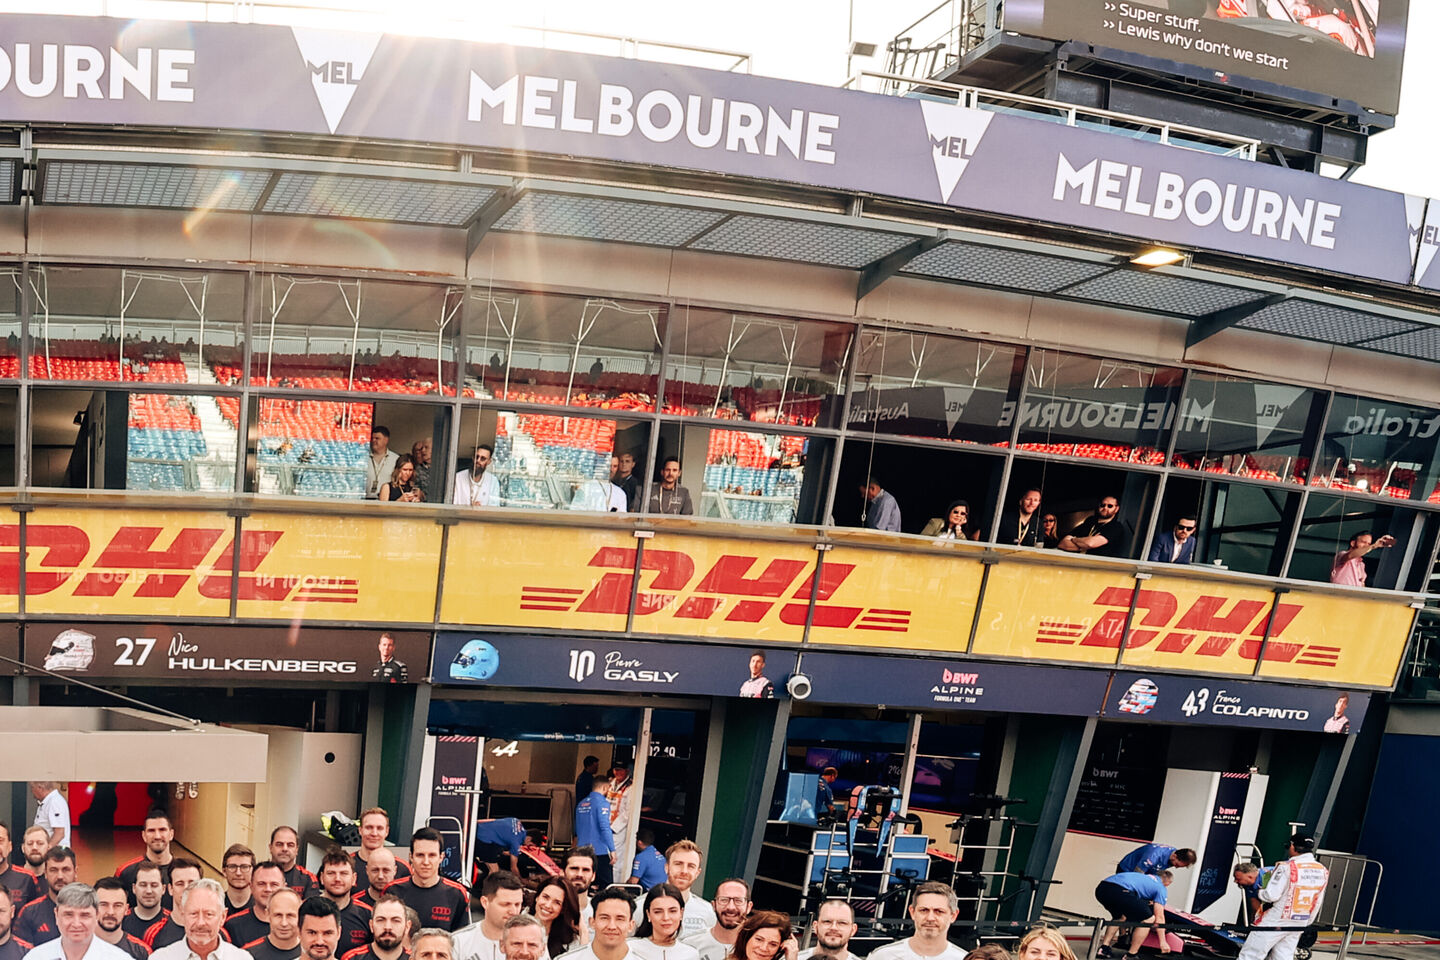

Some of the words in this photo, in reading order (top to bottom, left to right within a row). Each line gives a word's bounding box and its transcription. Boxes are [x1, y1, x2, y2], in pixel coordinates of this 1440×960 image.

[1119, 2, 1161, 24] Super
[1164, 13, 1202, 32] stuff.
[1118, 20, 1160, 41] Lewis
[1162, 31, 1193, 50] why
[1195, 38, 1230, 57] don't
[1232, 48, 1254, 61] we
[1256, 51, 1289, 70] start
[306, 59, 360, 85] MEL
[466, 70, 840, 166] MELBOURNE
[930, 132, 973, 159] MEL
[1052, 151, 1342, 250] MELBOURNE
[575, 546, 864, 628] DHL
[1079, 586, 1304, 663] DHL
[114, 637, 157, 666] 27
[168, 632, 199, 657] Nico
[168, 657, 357, 674] HULKENBERG
[568, 650, 596, 682] 10
[605, 651, 643, 670] Pierre
[604, 669, 679, 683] GASLY
[930, 686, 984, 695] ALPINE
[1181, 688, 1209, 717] 43
[1213, 690, 1241, 705] Franco
[1212, 705, 1309, 720] COLAPINTO
